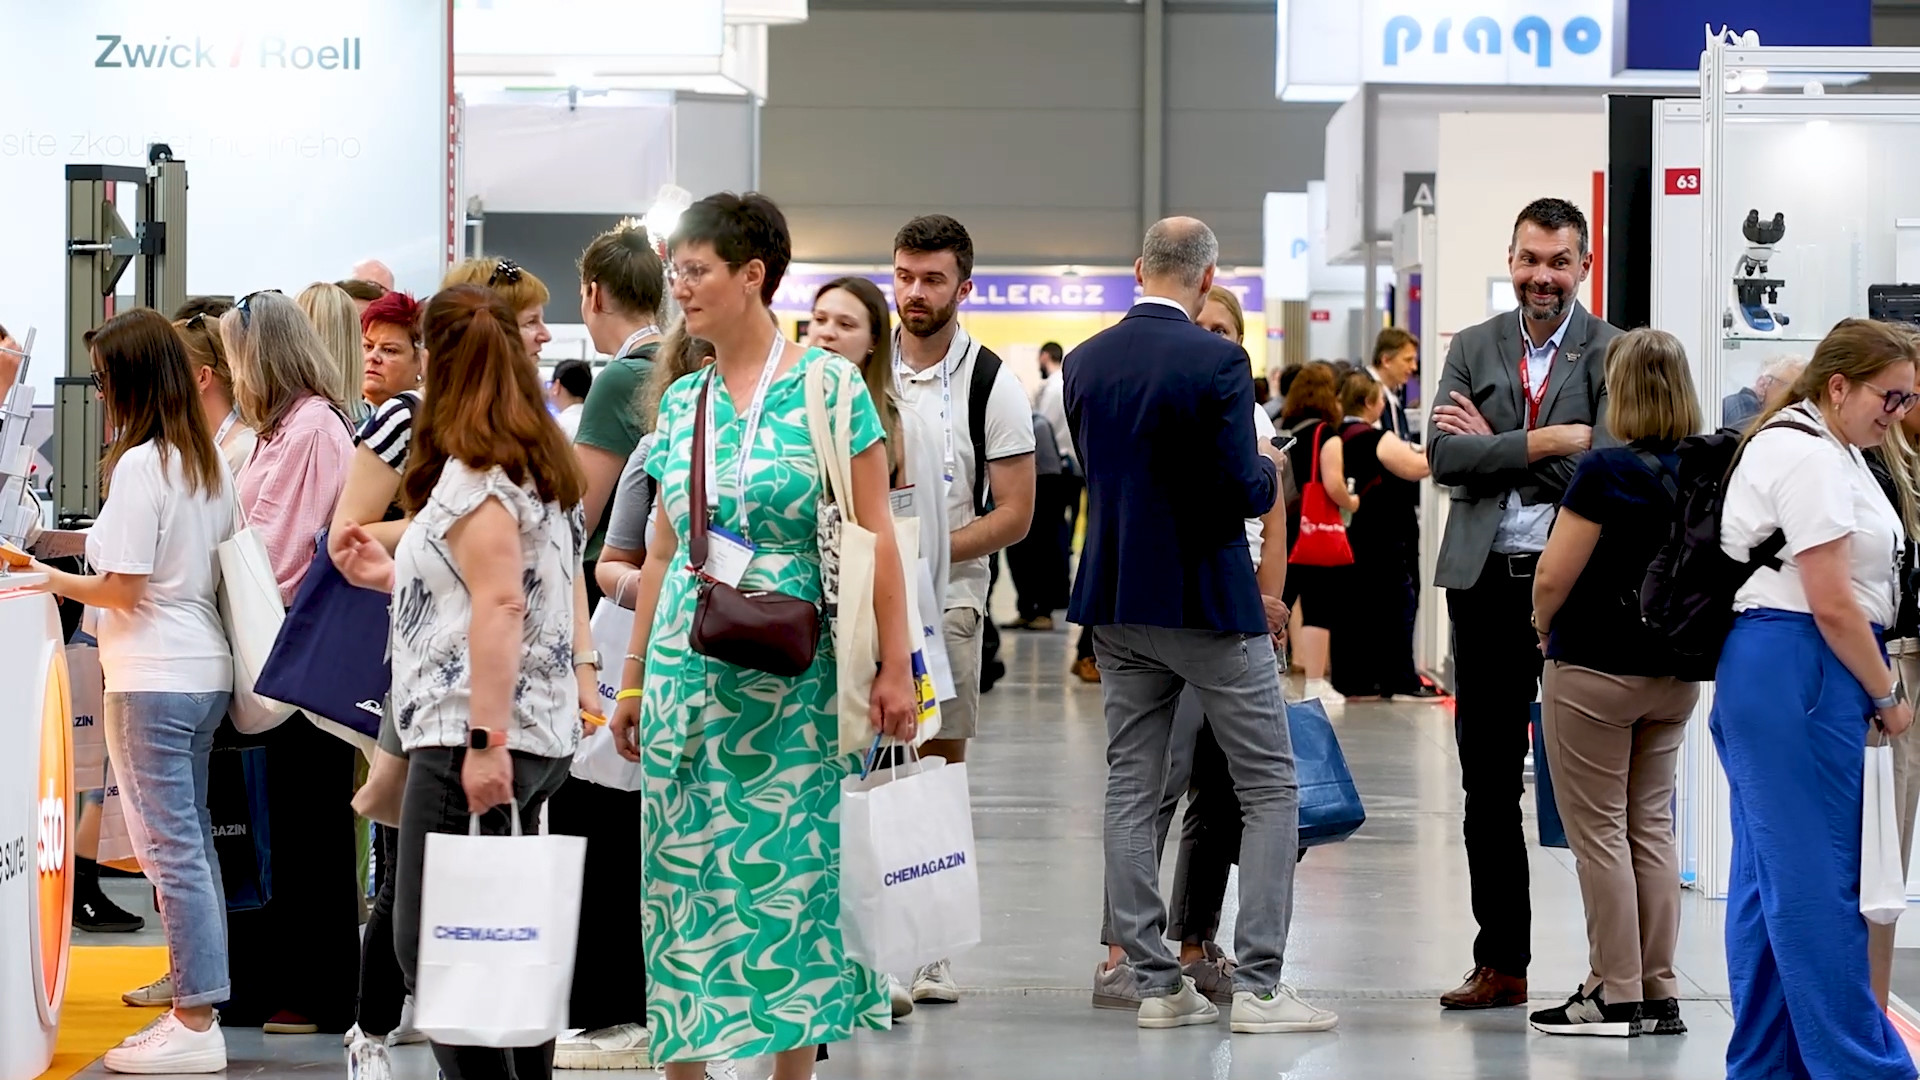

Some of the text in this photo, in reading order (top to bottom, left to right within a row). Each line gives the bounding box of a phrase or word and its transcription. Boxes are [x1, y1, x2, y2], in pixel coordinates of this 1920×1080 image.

[94, 34, 216, 69] Zwick
[259, 37, 362, 70] Roell
[1677, 174, 1698, 189] 63
[966, 284, 1104, 306] LLER.CZ
[38, 778, 65, 872] sto
